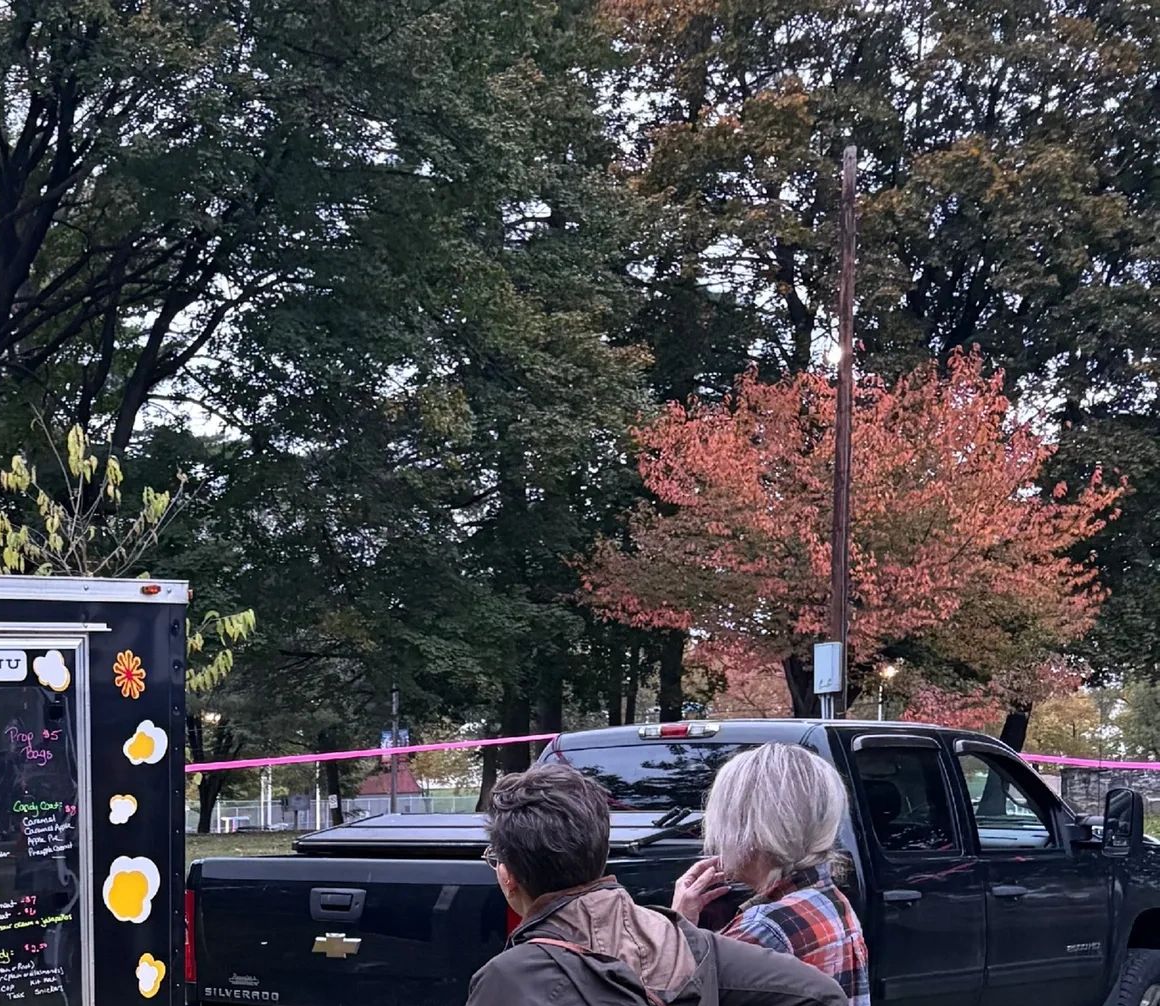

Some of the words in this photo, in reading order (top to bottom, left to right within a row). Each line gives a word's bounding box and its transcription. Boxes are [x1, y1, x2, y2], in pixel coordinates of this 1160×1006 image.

[4, 726, 34, 749] Prop
[42, 729, 62, 741] $5
[13, 800, 39, 817] Candy
[23, 814, 56, 827] Caramel
[27, 836, 46, 846] Apple
[204, 987, 279, 1000] SILVERADO
